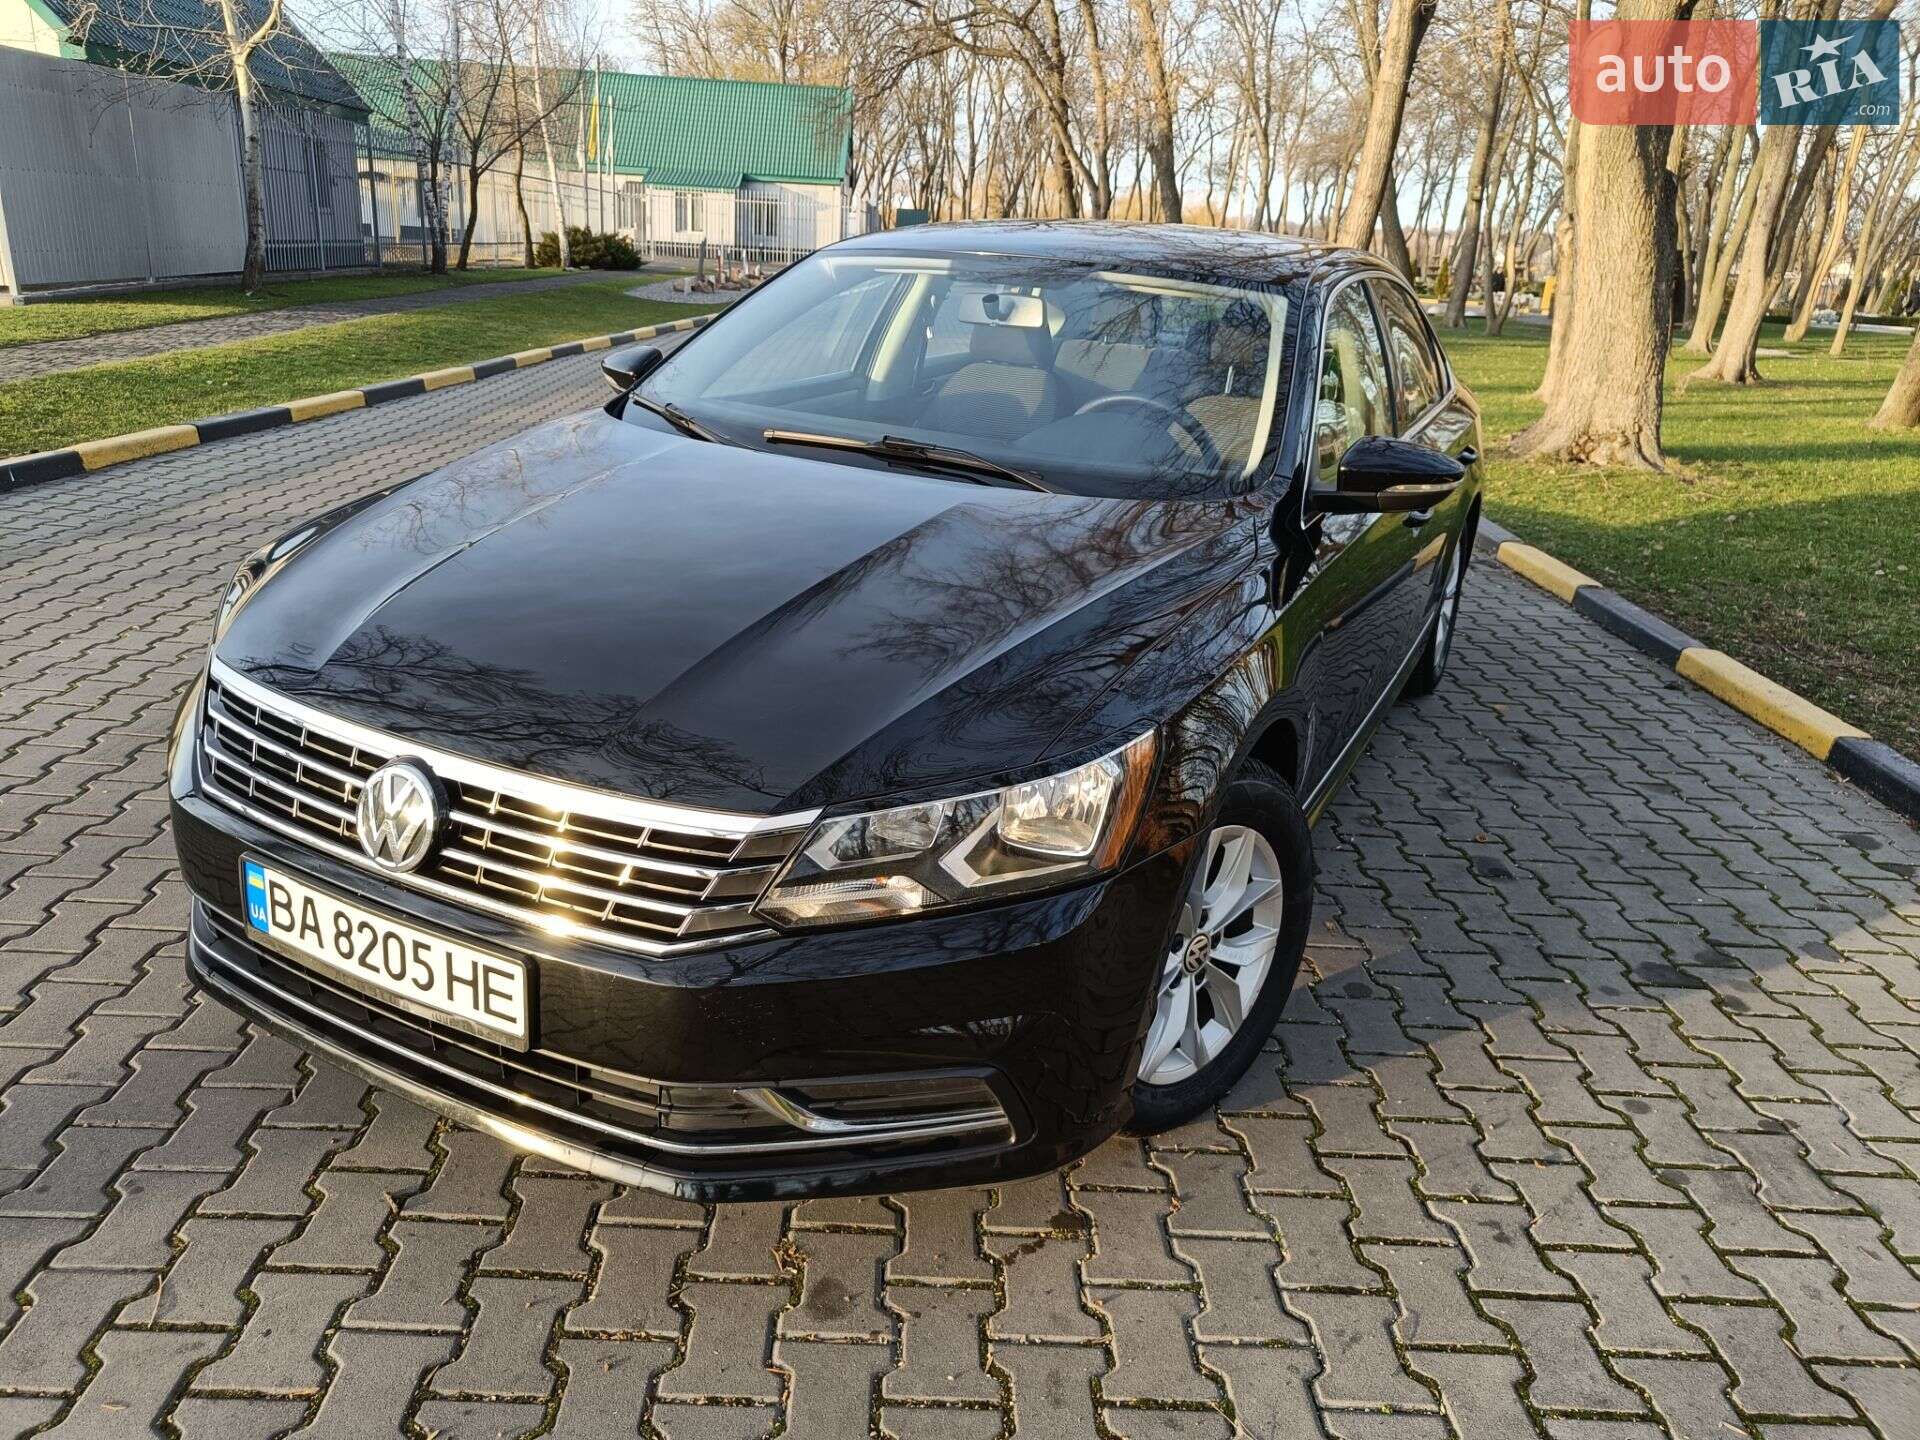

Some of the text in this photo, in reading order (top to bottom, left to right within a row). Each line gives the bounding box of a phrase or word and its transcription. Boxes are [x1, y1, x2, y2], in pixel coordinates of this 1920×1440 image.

[250, 902, 267, 923] UA
[269, 879, 325, 949] BA
[333, 910, 435, 992] 8205
[445, 951, 519, 1025] HE
